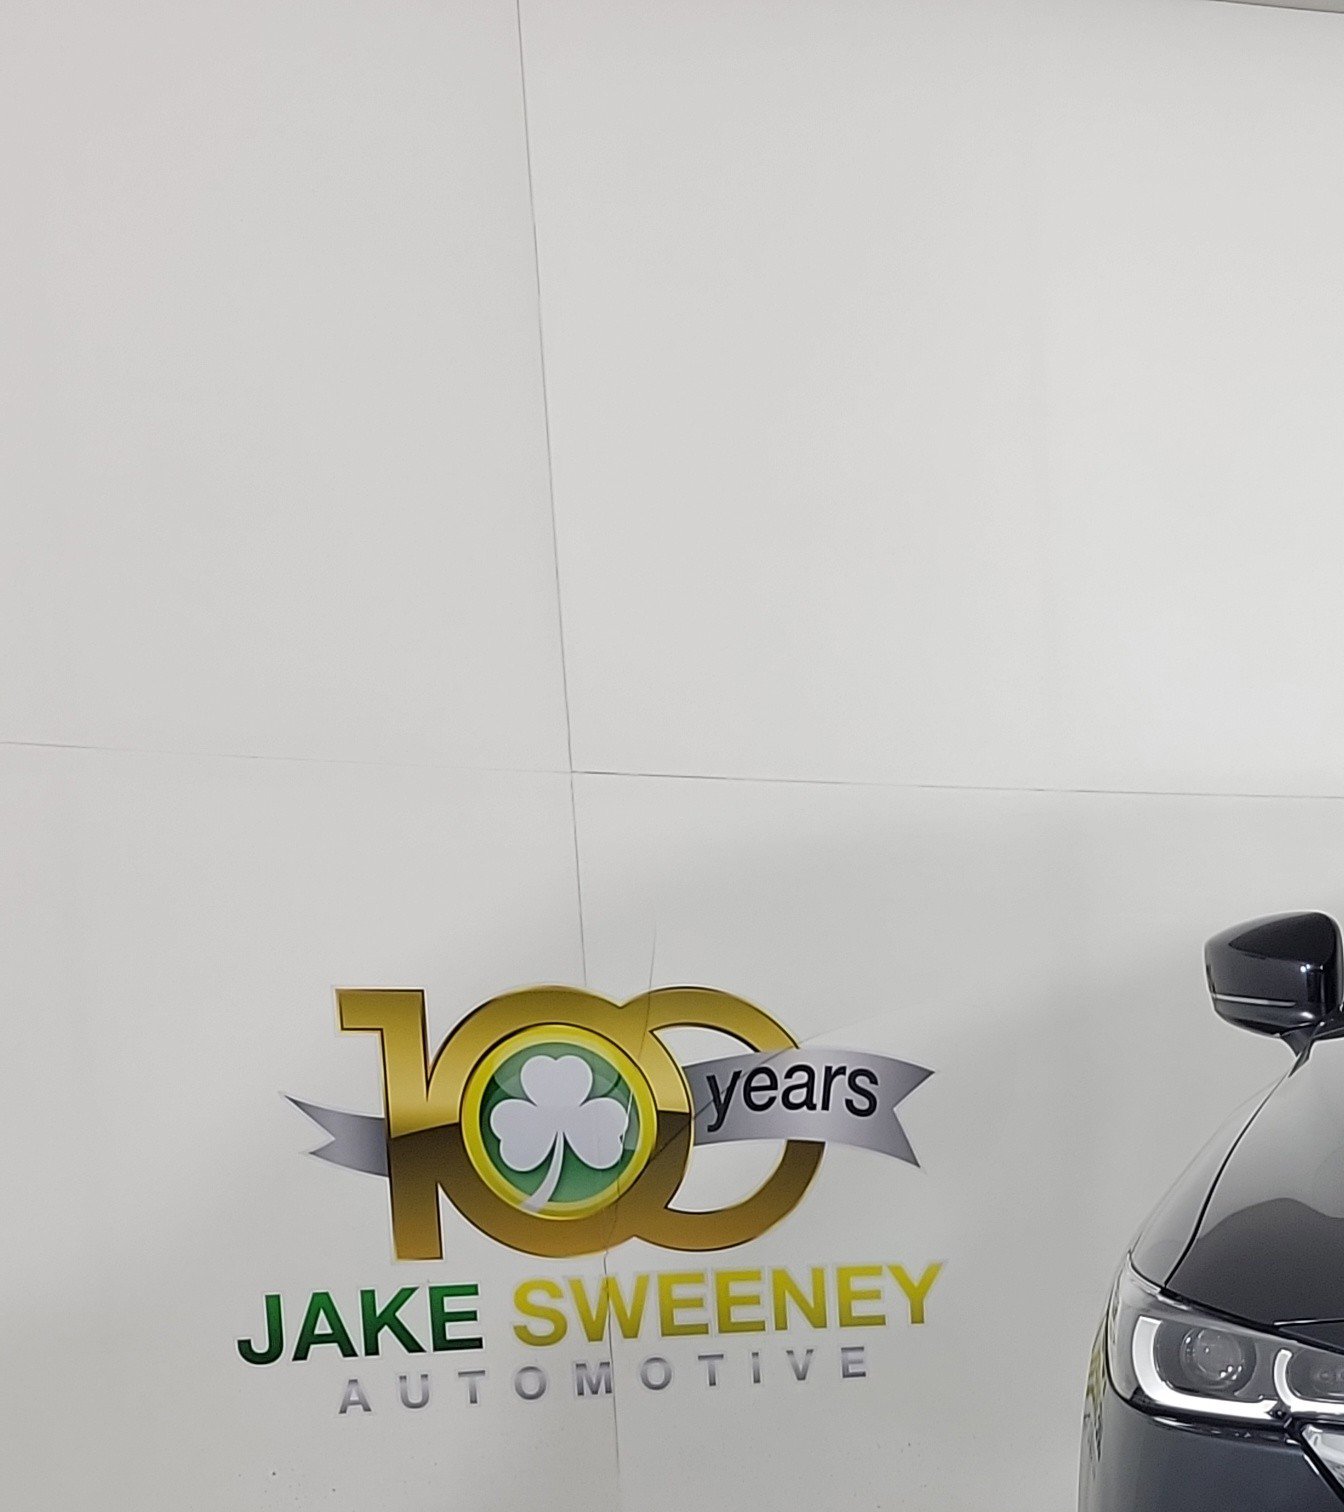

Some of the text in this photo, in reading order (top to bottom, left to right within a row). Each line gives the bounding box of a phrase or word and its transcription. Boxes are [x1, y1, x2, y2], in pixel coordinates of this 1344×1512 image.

[335, 985, 880, 1261] 100 years
[236, 1261, 944, 1366] JAKE SWEENEY
[337, 1345, 868, 1415] AUTOMOTIVE
